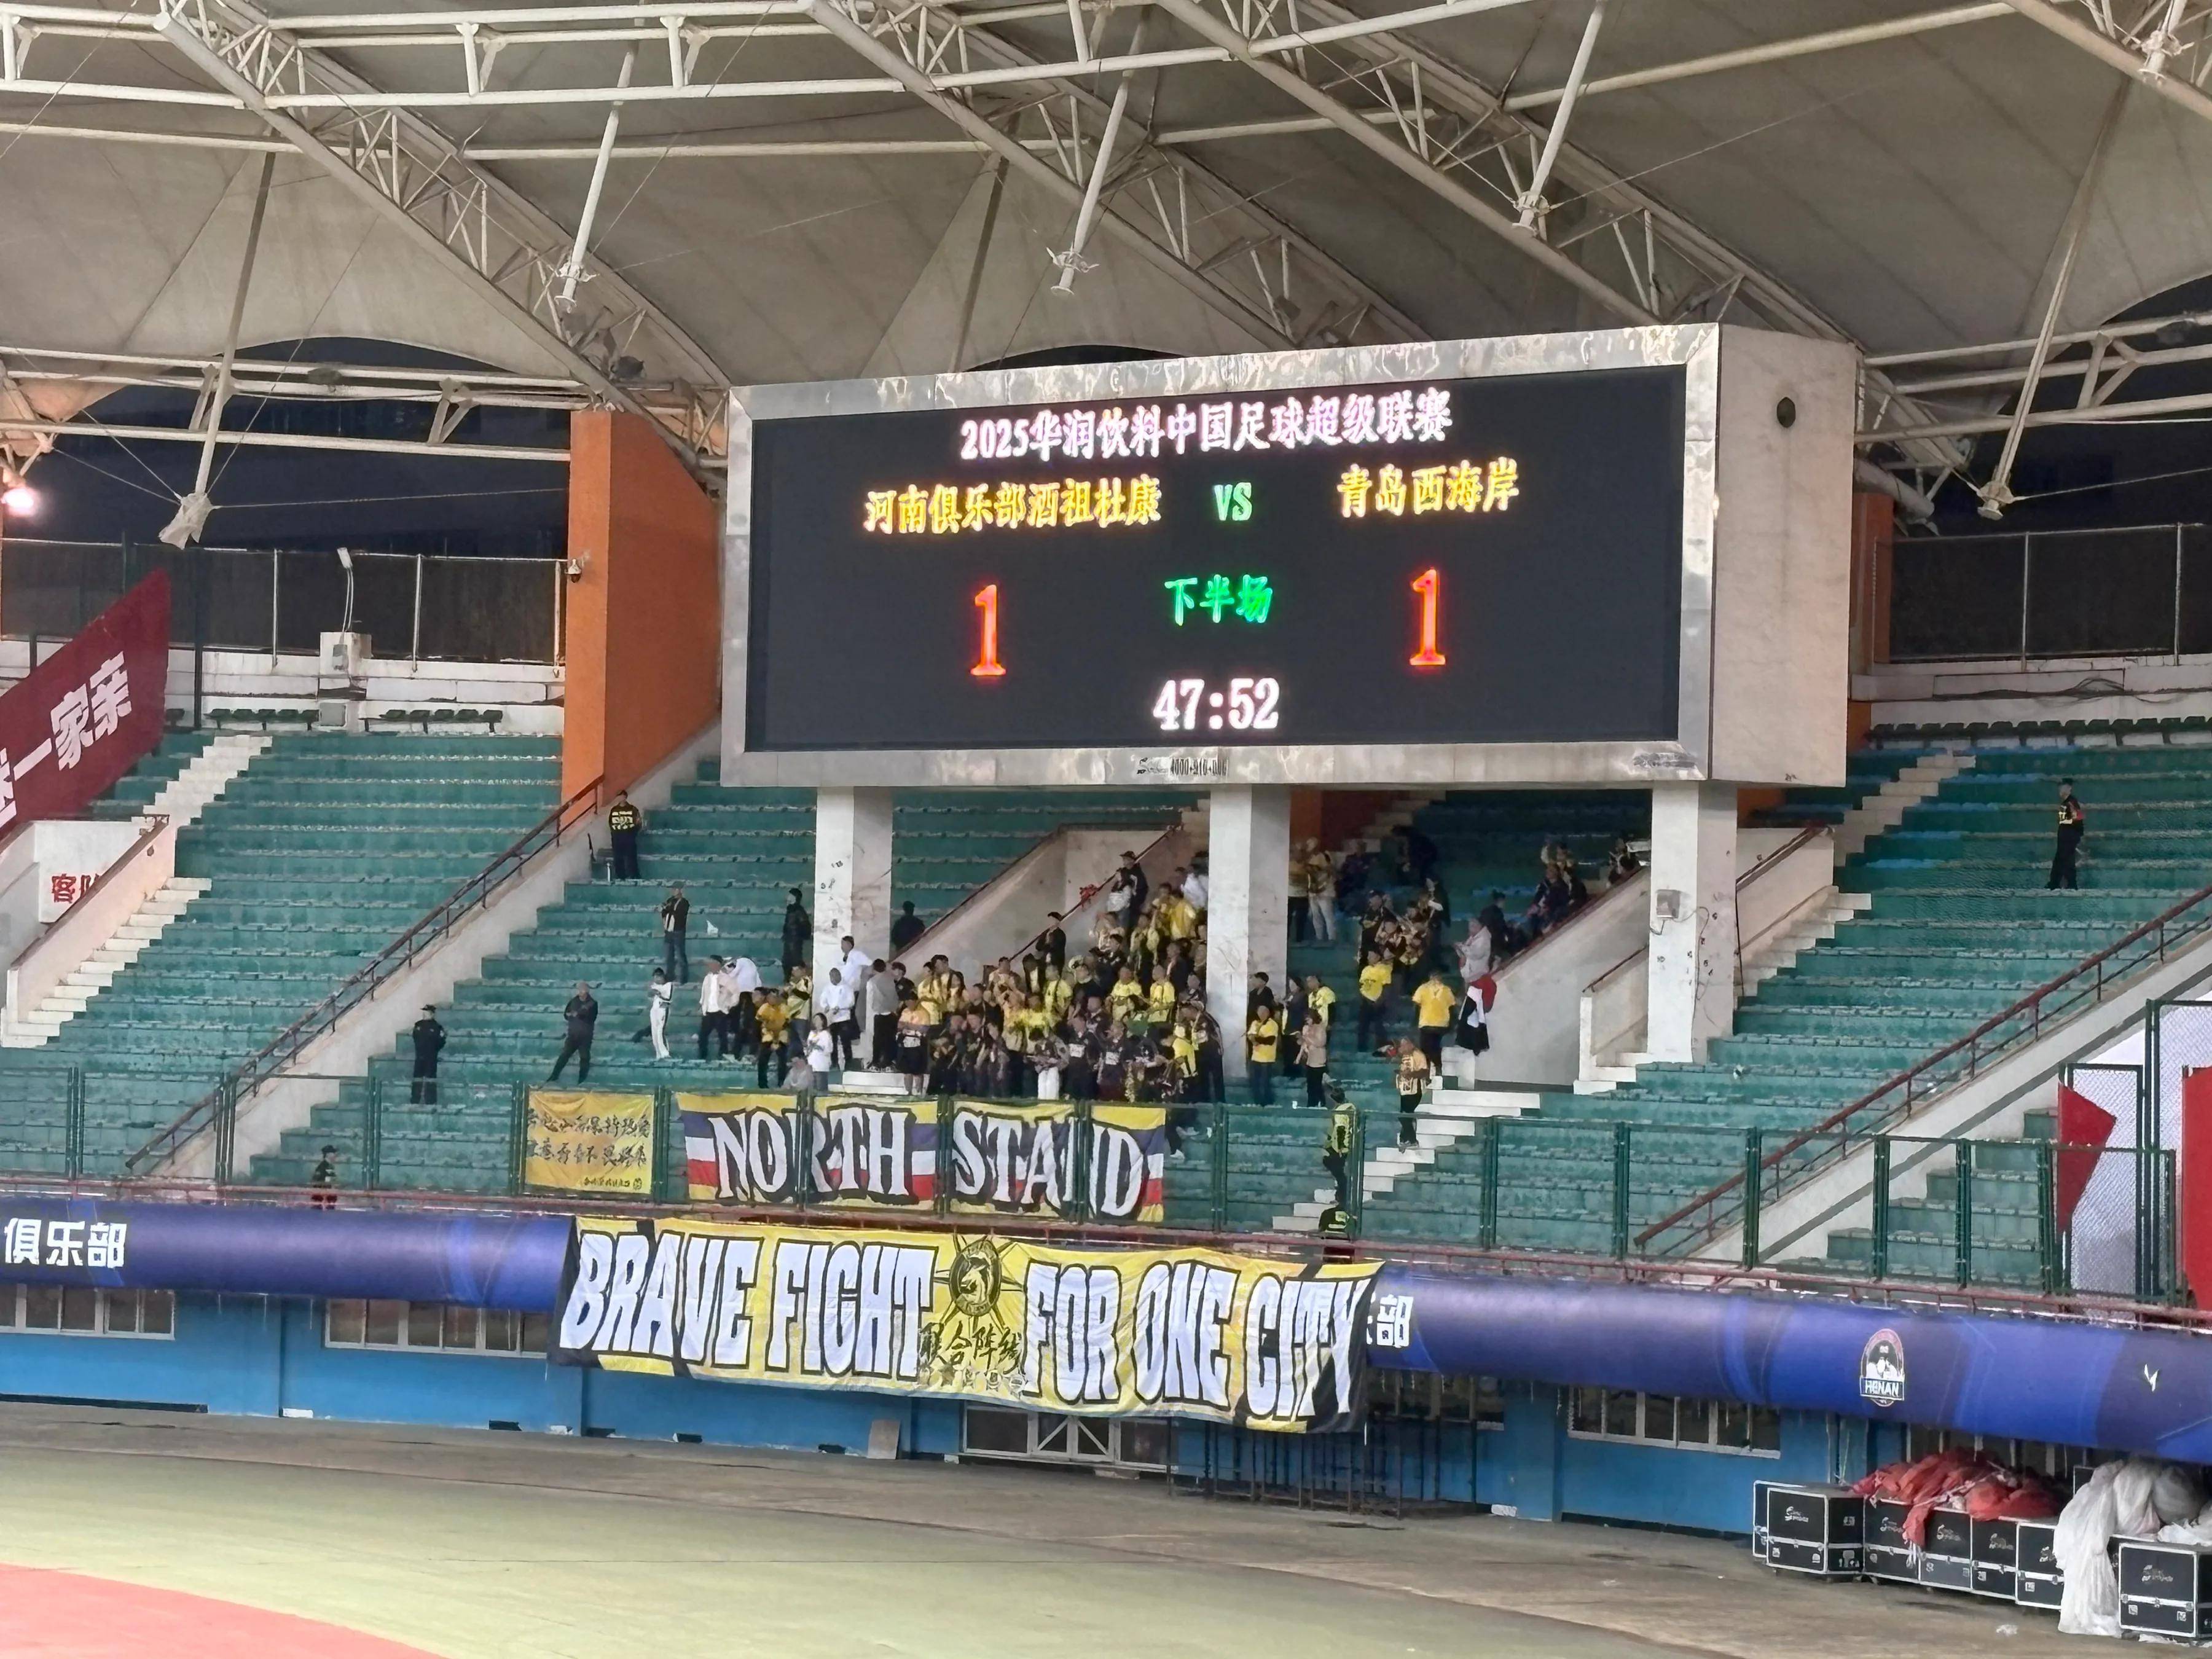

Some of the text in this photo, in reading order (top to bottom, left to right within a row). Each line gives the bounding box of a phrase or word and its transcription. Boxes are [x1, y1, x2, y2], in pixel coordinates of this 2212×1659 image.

[960, 387, 1453, 461] 2025华润饮料中国足球超级联赛
[863, 474, 1161, 533] 河南俱乐部酒祖杜康
[1214, 482, 1252, 521] VS
[1337, 457, 1519, 518] 青岛西海岸
[971, 584, 1006, 676] 1
[1164, 574, 1273, 626] 下半场
[1410, 569, 1446, 665] 1
[1152, 678, 1280, 731] 47:52
[708, 1107, 914, 1201] NORTH
[4, 1218, 127, 1268] 俱乐部
[559, 1231, 763, 1368] BRAVE
[766, 1238, 938, 1382] FIGHT
[1022, 1259, 1123, 1404] FOR
[1131, 1260, 1242, 1411] ONE
[1243, 1273, 1371, 1421] CITY
[1865, 1379, 1899, 1398] HENAN
